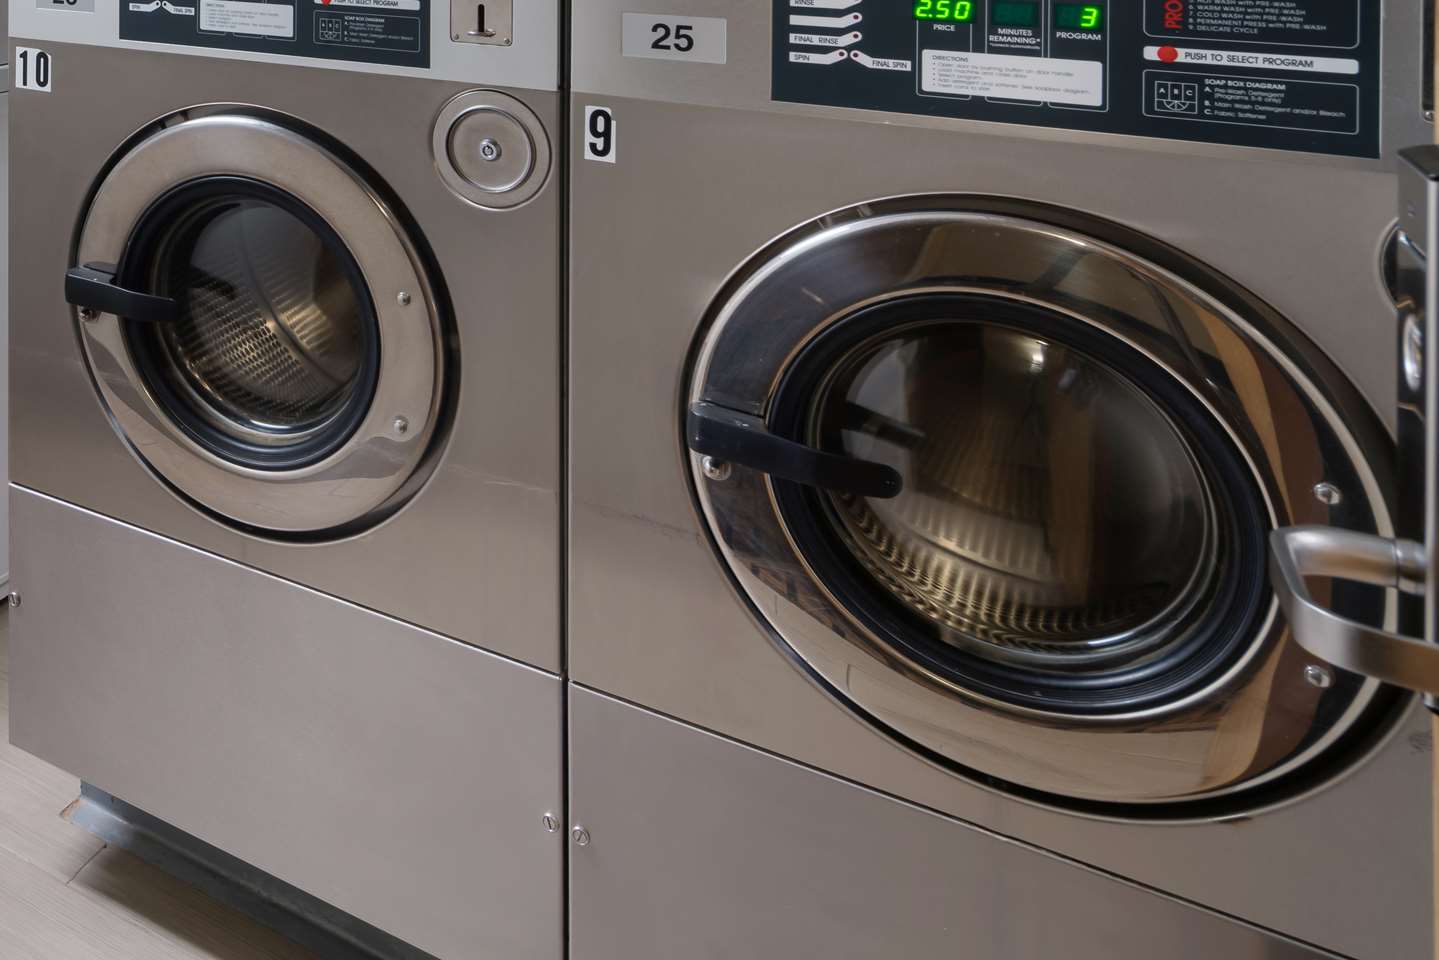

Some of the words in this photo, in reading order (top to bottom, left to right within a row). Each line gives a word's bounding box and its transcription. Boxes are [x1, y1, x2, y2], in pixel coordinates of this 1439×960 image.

[916, 0, 971, 19] 2.50
[1081, 8, 1098, 27] 3
[651, 23, 694, 51] 25
[998, 28, 1032, 36] MINUTES
[1056, 31, 1101, 40] PROGRAM
[1197, 25, 1231, 33] DELICATE
[1185, 52, 1207, 61] PUSH
[1211, 54, 1223, 62] TO
[1227, 55, 1259, 64] SELECT
[1263, 57, 1313, 68] PROGRAM
[19, 51, 48, 87] 10
[1247, 81, 1286, 90] DIAGRAM
[589, 109, 612, 157] 9
